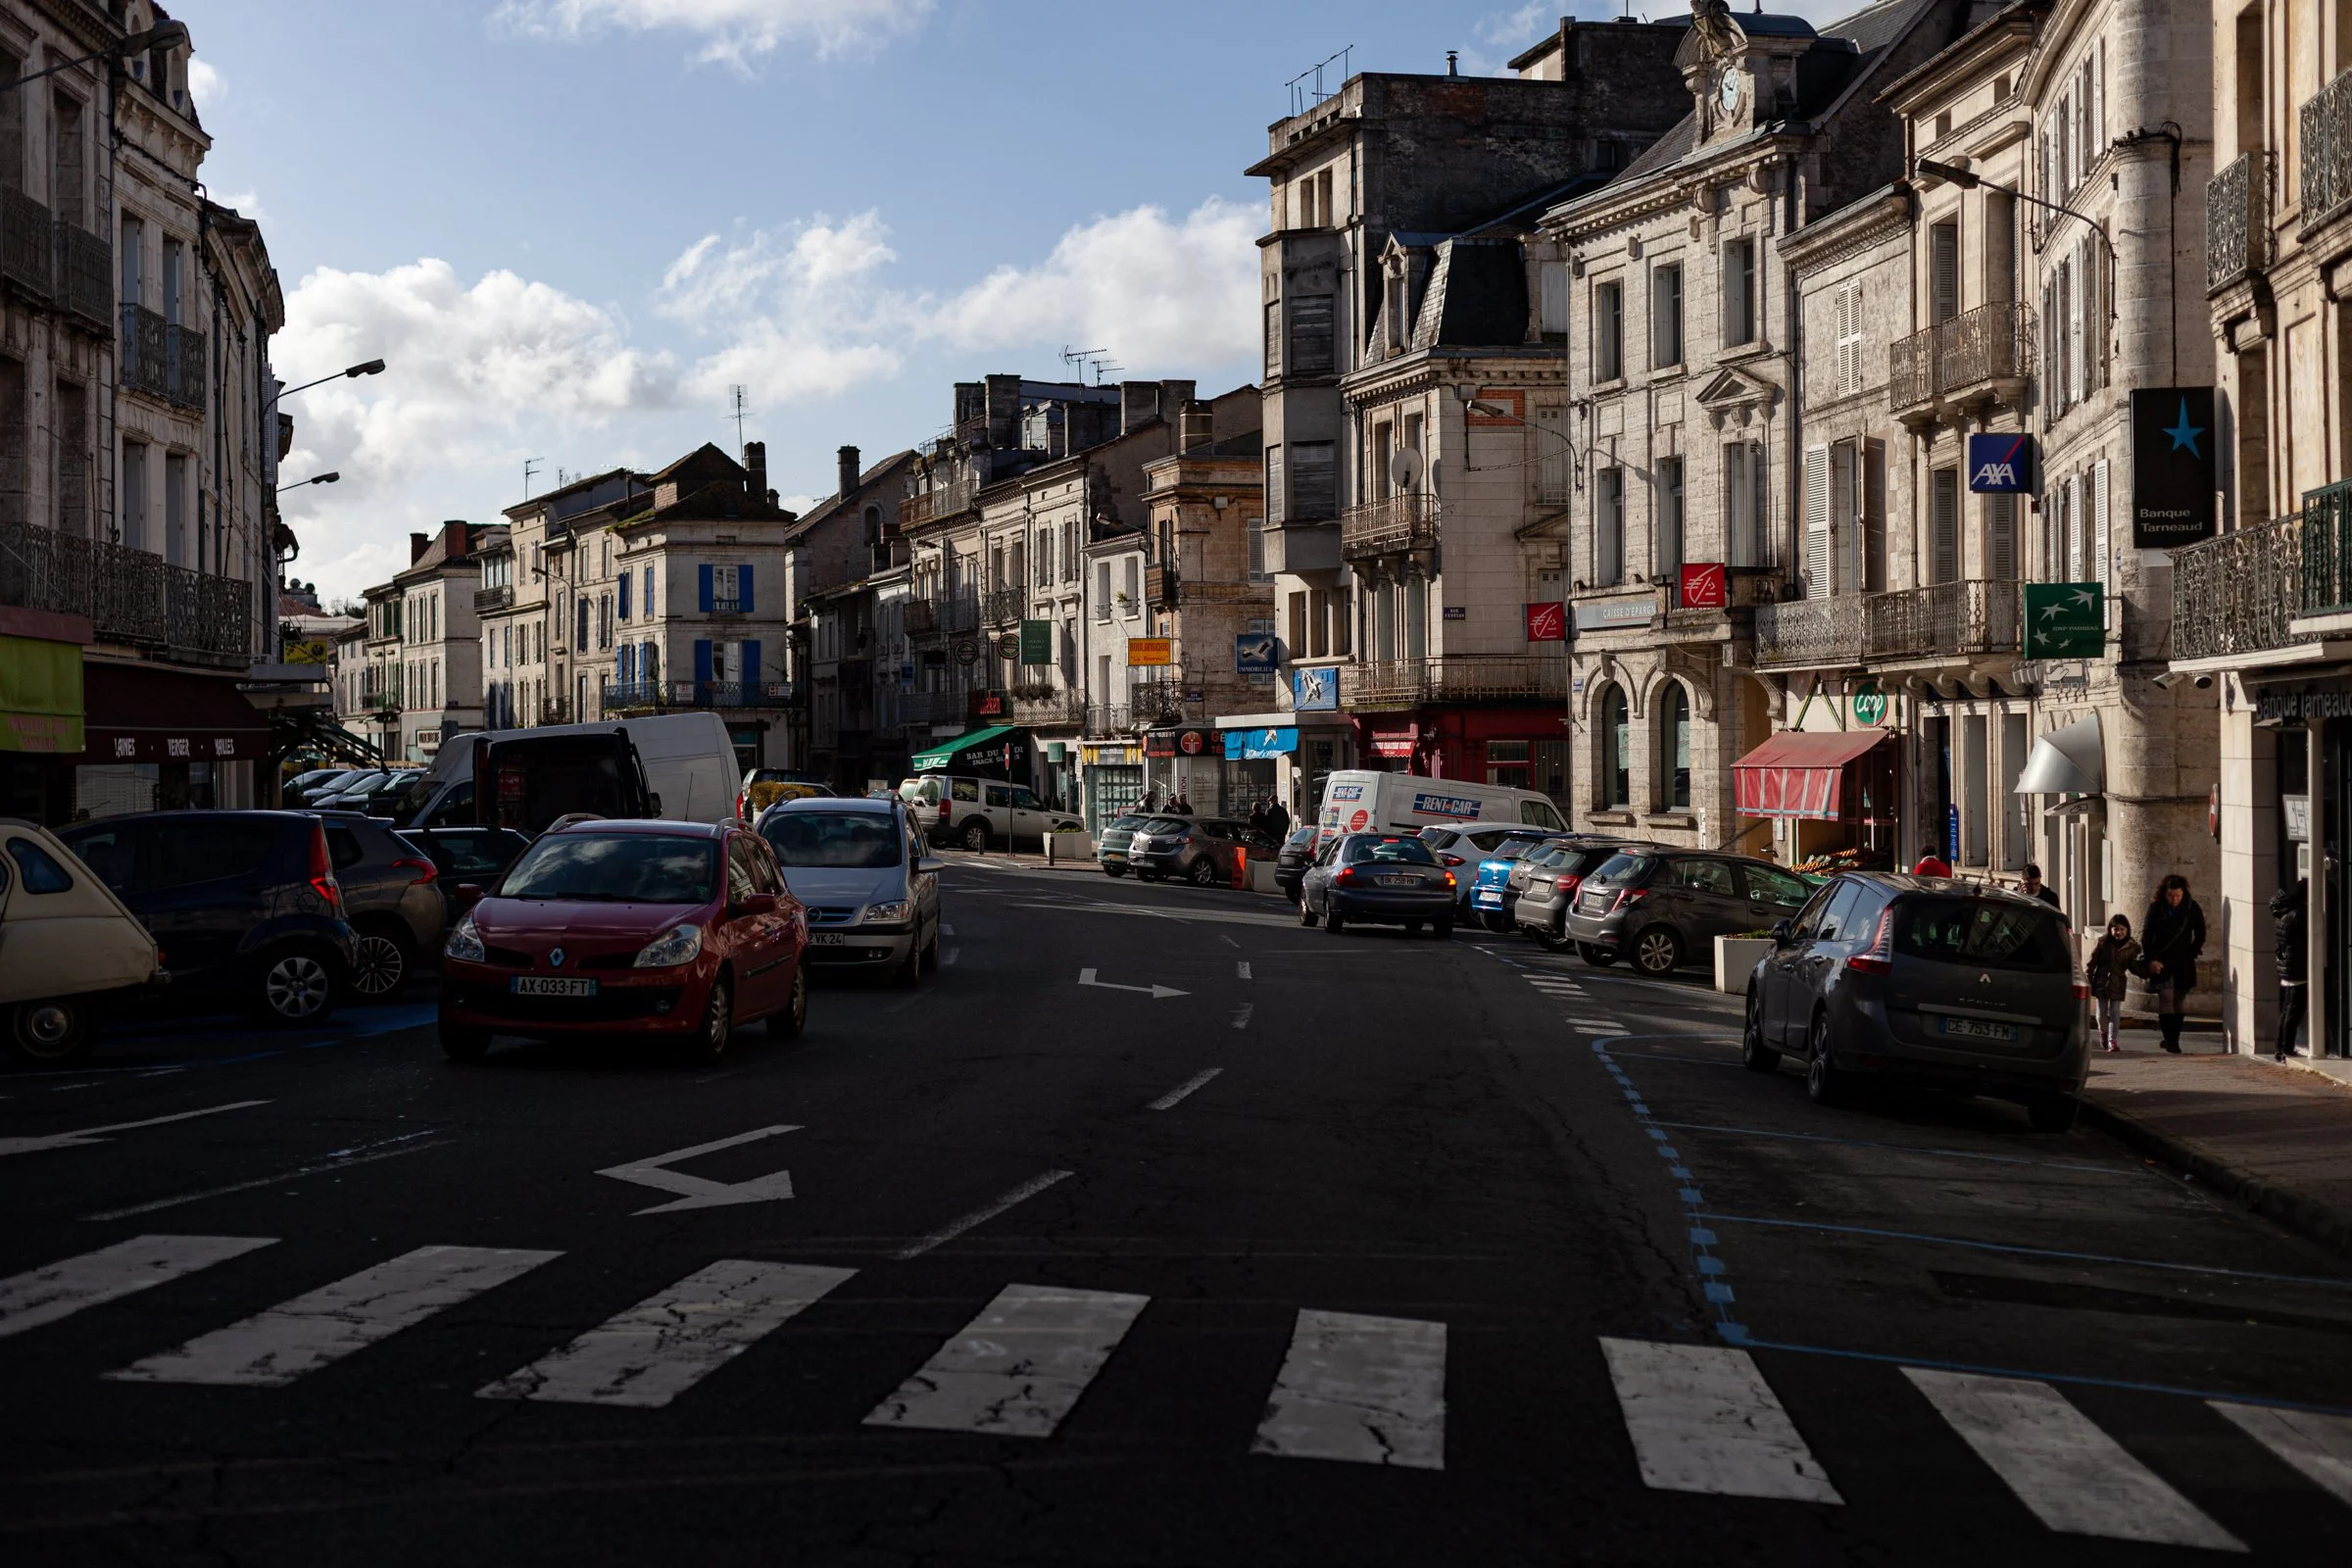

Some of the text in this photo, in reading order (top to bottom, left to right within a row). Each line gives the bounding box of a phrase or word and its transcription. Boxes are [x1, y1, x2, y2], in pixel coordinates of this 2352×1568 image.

[1971, 463, 2017, 485] AXA
[2139, 508, 2191, 519] Banque
[2140, 521, 2203, 532] Tarneaud
[1602, 604, 1656, 619] CAISSE D'EPARGN
[1129, 642, 1169, 653] BOULANGERIE
[2256, 690, 2298, 726] Banque
[965, 750, 985, 760] BAR
[987, 749, 1000, 758] DU
[1422, 796, 1446, 812] RENT
[1450, 800, 1473, 815] CAR
[815, 933, 828, 945] VK
[829, 933, 843, 945] 24
[519, 978, 588, 995] AX-033-FT
